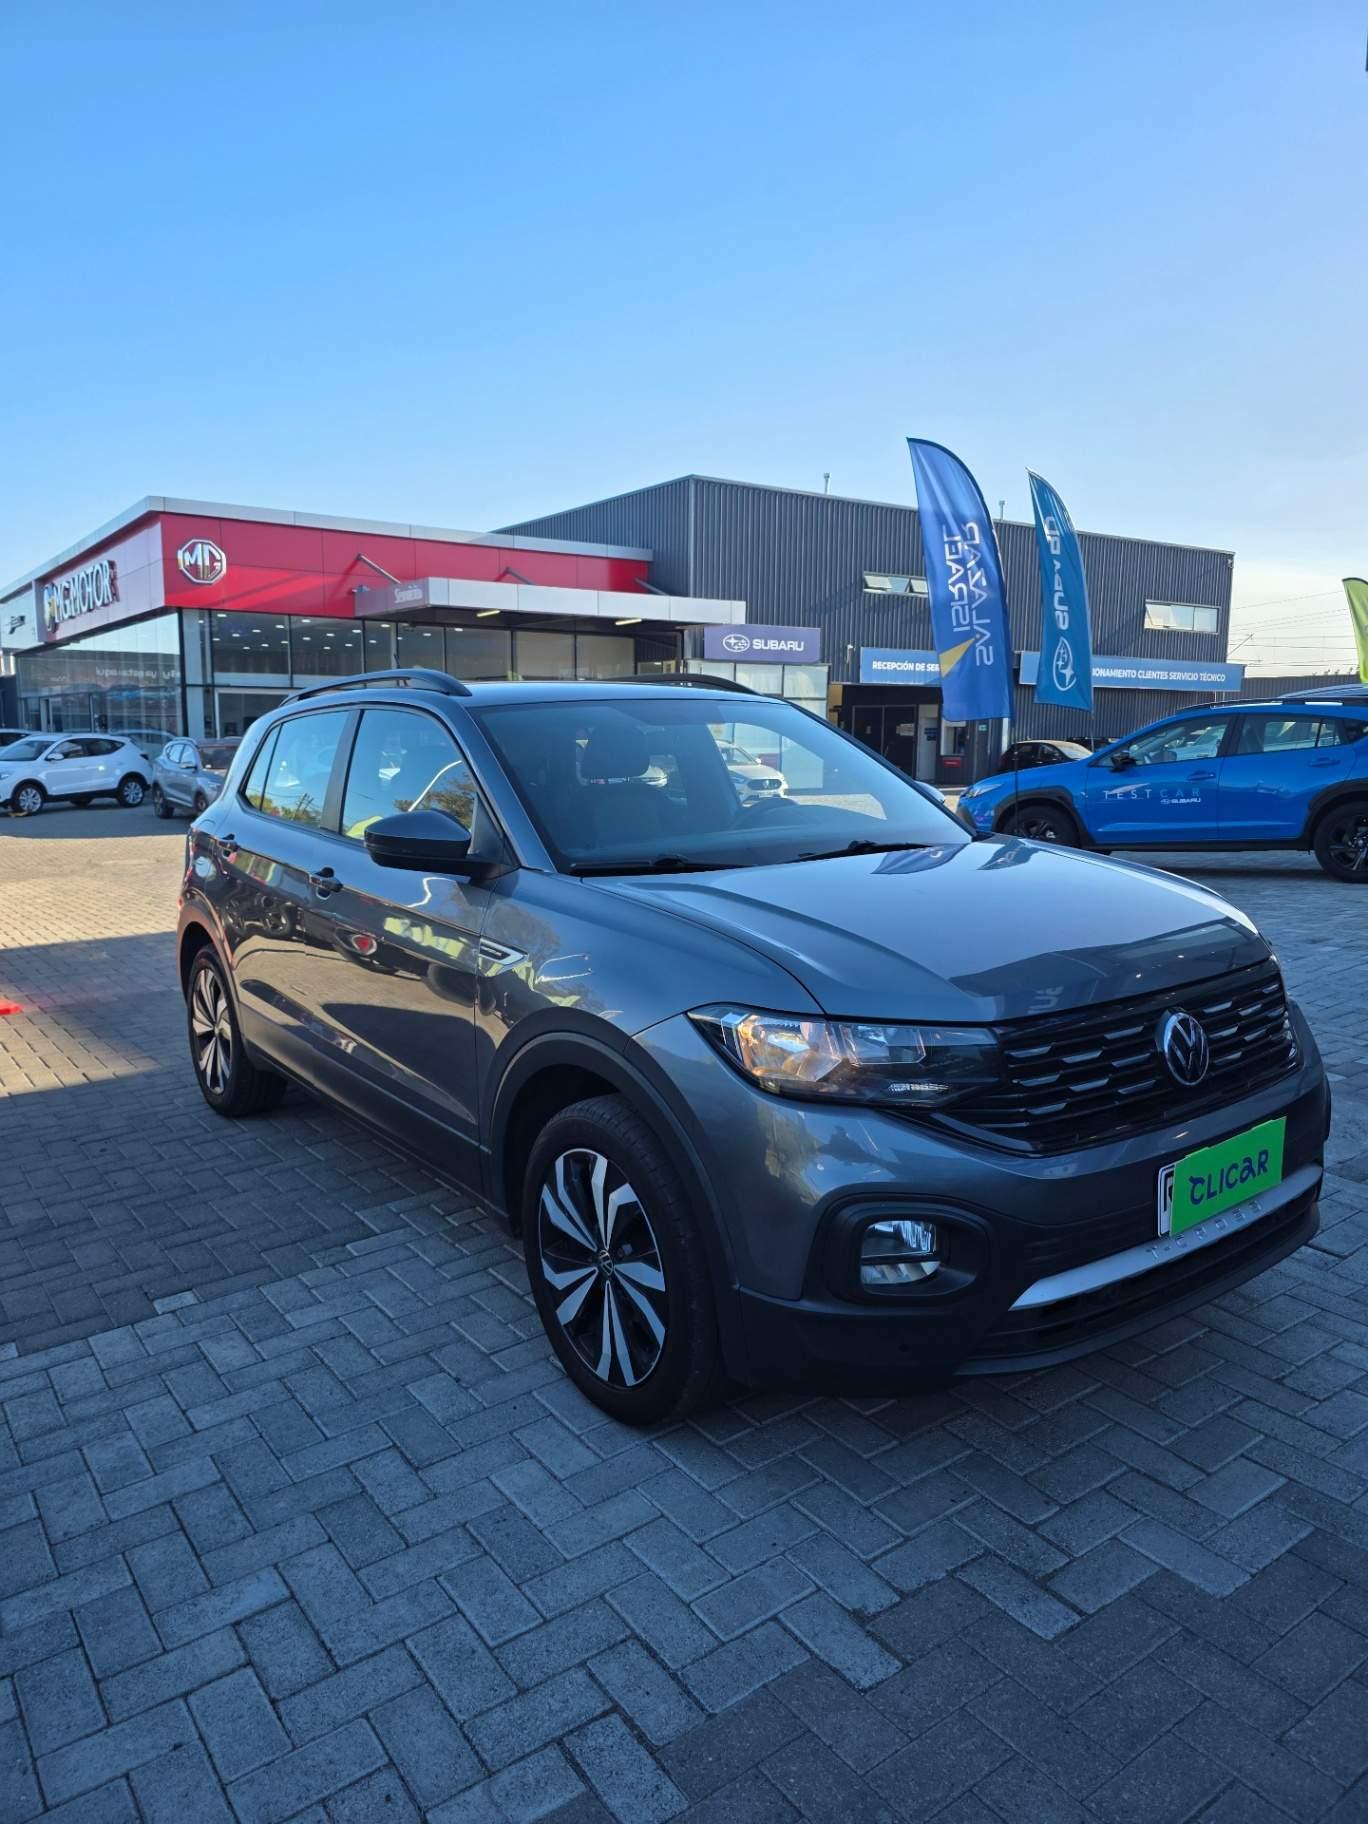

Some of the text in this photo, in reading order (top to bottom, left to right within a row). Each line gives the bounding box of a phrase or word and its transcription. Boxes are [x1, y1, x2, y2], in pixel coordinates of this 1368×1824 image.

[183, 543, 222, 579] MG
[752, 639, 804, 652] SUBARU
[872, 660, 914, 671] RECEPCIÓN
[915, 663, 925, 671] DE
[1137, 670, 1169, 679] CLIENTES
[1169, 671, 1199, 681] SERVICIO
[1199, 672, 1226, 682] TÉCNICO
[1103, 788, 1152, 800] TEST
